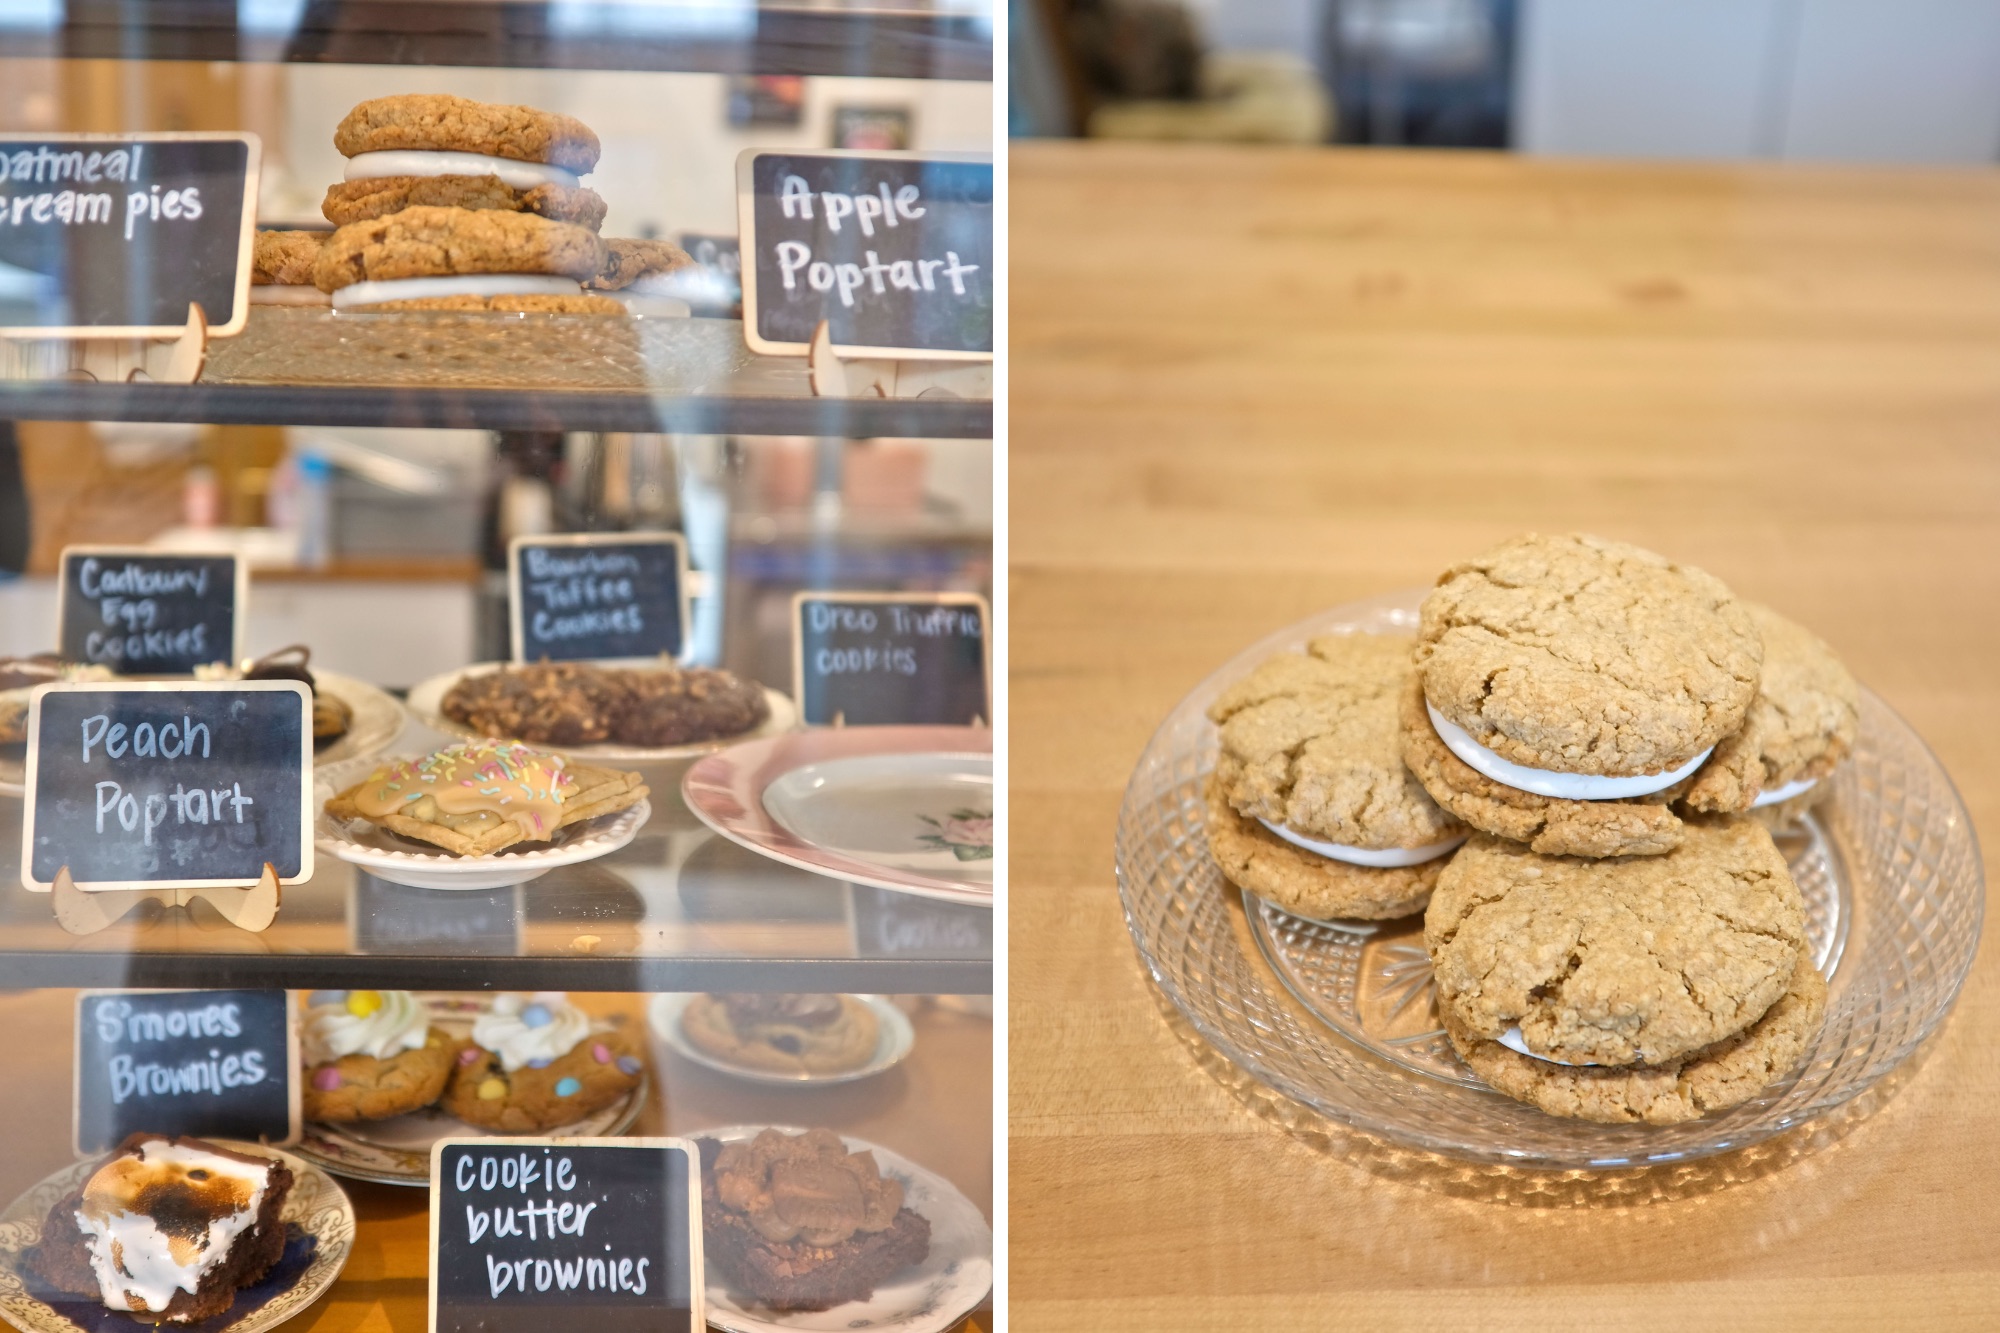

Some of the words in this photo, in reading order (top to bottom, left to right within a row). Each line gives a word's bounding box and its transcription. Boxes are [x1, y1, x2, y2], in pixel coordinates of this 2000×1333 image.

[124, 184, 203, 240] pies
[781, 174, 926, 236] Apple
[776, 240, 980, 307] Poptart
[81, 715, 211, 764] Peach
[95, 780, 253, 847] Poptart
[95, 1000, 242, 1043] S'mores
[109, 1050, 265, 1104] Brownies
[455, 1148, 577, 1194] cookie
[466, 1199, 597, 1244] butter
[486, 1244, 650, 1299] brownies
